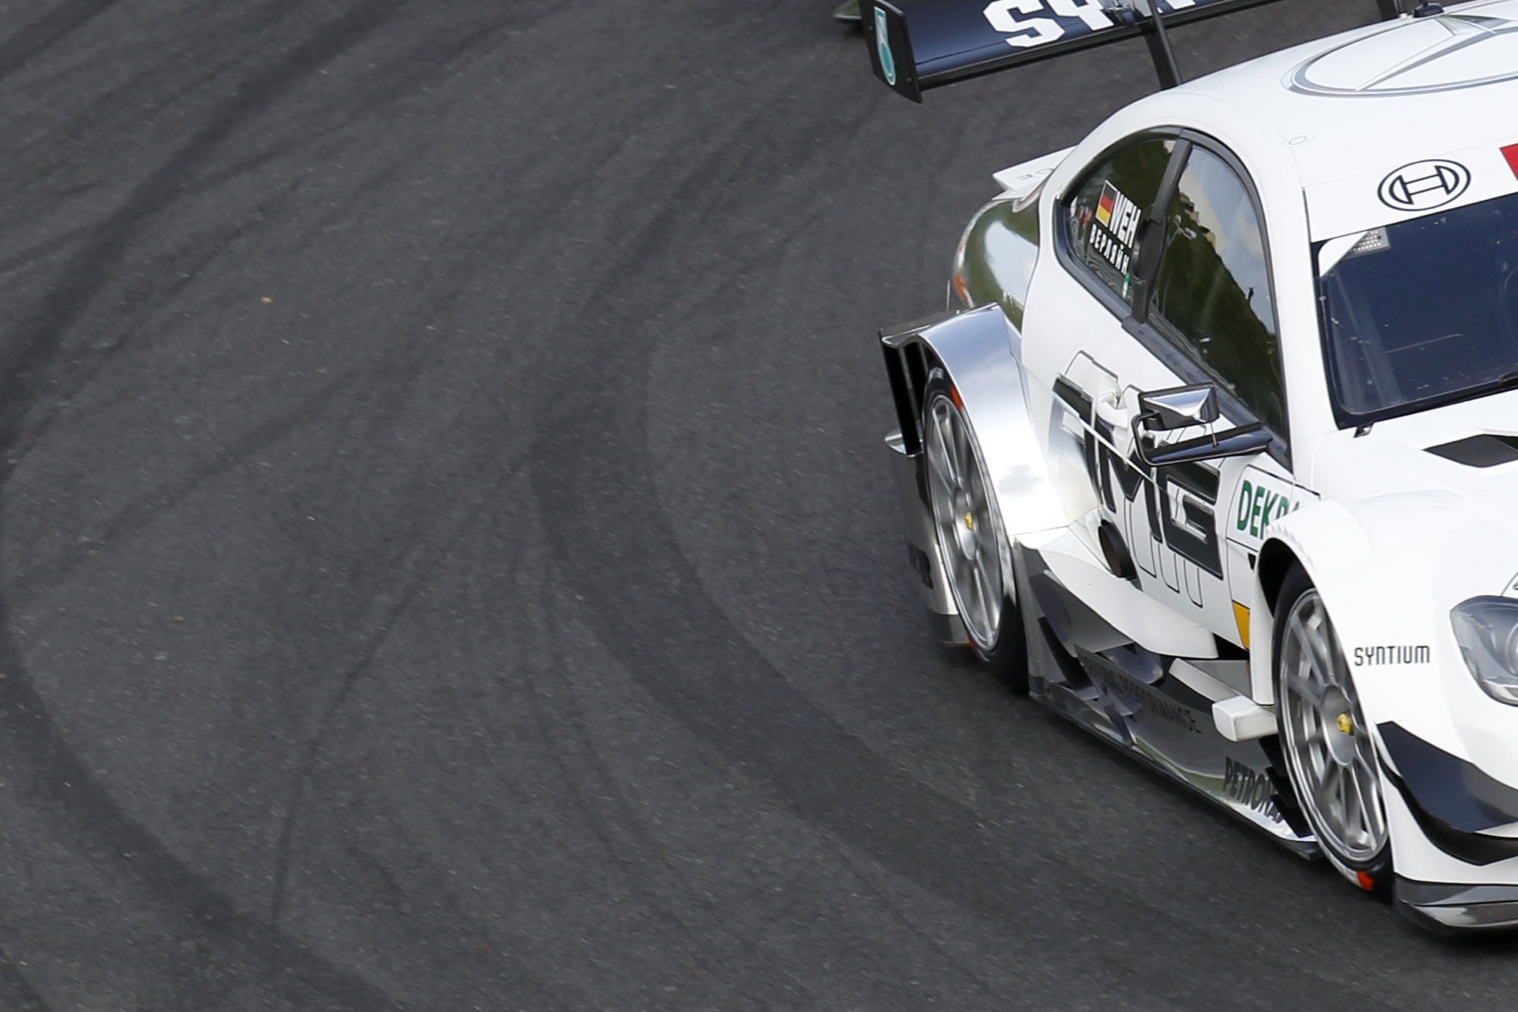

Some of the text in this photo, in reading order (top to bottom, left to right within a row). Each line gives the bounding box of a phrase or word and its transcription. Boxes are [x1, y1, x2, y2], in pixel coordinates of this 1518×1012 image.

[1237, 479, 1300, 540] DEKR
[1354, 645, 1431, 666] SYNTIUM
[1222, 756, 1283, 825] PETRONA
